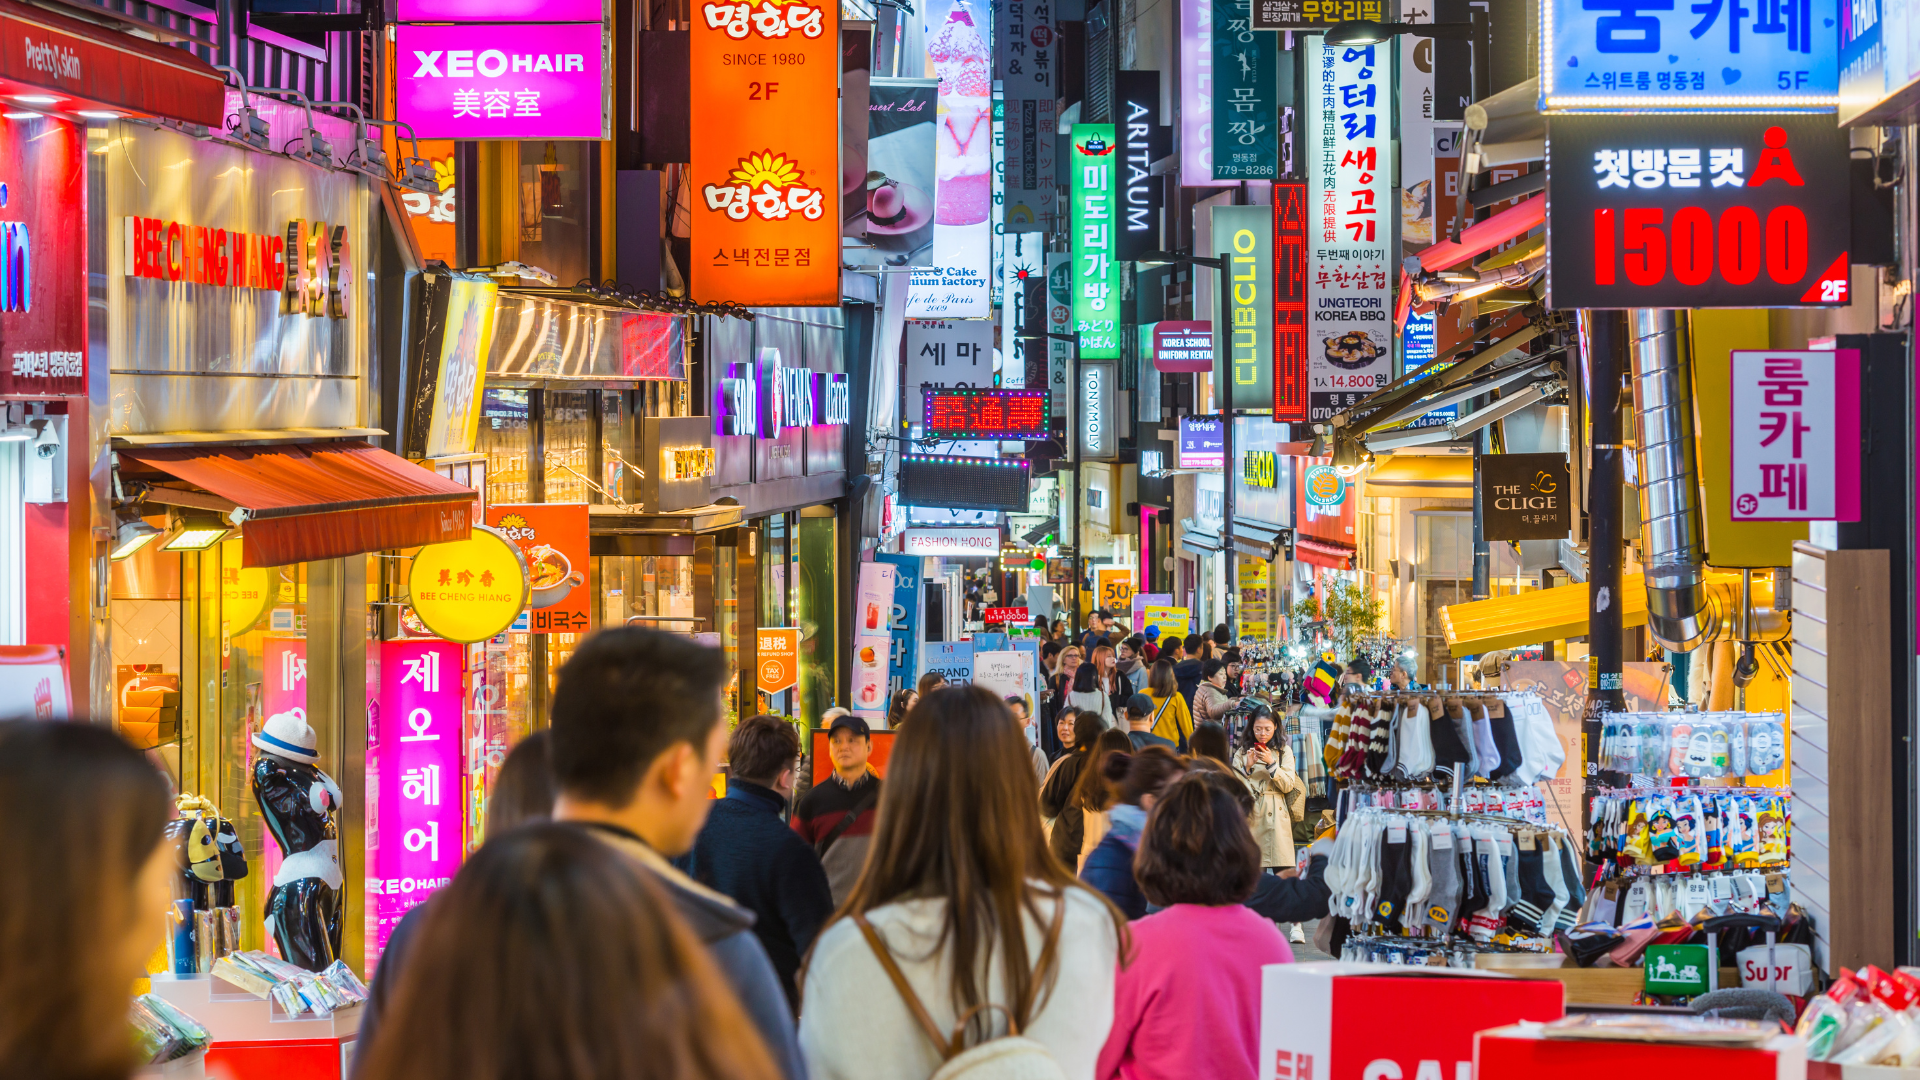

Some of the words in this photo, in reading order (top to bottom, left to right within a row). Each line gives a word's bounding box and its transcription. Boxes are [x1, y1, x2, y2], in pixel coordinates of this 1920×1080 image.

[704, 1, 824, 39] 명화당
[1302, 1, 1381, 22] 무한리필
[1009, 0, 1027, 56] 덕피자
[1034, 0, 1050, 87] 석떡볶이
[413, 49, 509, 78] XEO
[512, 54, 584, 73] HAIR
[723, 53, 767, 66] SINCE
[772, 53, 806, 66] 1980
[1584, 71, 1651, 90] 스위트룸
[1657, 71, 1706, 90] 명동점
[1778, 71, 1810, 90] 5F
[749, 82, 779, 101] 2F
[453, 87, 542, 119] 美容室
[897, 99, 926, 112] Lab
[1024, 101, 1034, 124] Pizza
[1227, 88, 1266, 145] 몸짱
[1127, 100, 1150, 231] ARITAUM
[1232, 153, 1257, 163] 명동점
[1217, 166, 1274, 176] 779-8286
[1593, 148, 1702, 189] 첫방문
[1709, 148, 1745, 189] 컷
[704, 183, 823, 220] 명화당
[1083, 164, 1111, 311] 미도리가방
[1594, 204, 1809, 287] 15000
[133, 215, 164, 282] BEE
[165, 221, 229, 287] CHENG
[232, 232, 286, 292] HIANG
[713, 247, 811, 267] 스낵전문점
[1316, 249, 1350, 261] 두번째
[1352, 249, 1385, 261] 이야기
[946, 267, 977, 276] Cake
[1315, 267, 1386, 290] 무한삼겹
[942, 277, 987, 288] factory
[1820, 280, 1847, 301] 2F
[921, 292, 937, 304] de
[941, 293, 975, 305] Paris
[926, 304, 948, 312] 2009
[1318, 297, 1382, 308] UNGTEORI
[1078, 319, 1114, 332] みどり
[1315, 311, 1357, 322] KOREA
[1360, 311, 1386, 322] BBQ
[1079, 335, 1116, 349] かばん
[1162, 338, 1185, 348] KOREA
[1186, 338, 1212, 348] SCHOOL
[1158, 350, 1188, 360] UNIFORM
[782, 367, 813, 428] VENUS
[1087, 370, 1099, 450] TONYMOLY
[1757, 357, 1811, 511] 룸카페
[1493, 485, 1521, 495] THE
[1494, 496, 1557, 511] CLIGE
[1739, 496, 1757, 513] 5F
[440, 510, 453, 534] Since
[911, 536, 957, 548] FASHION
[961, 536, 992, 548] HONG
[420, 592, 437, 601] BEE
[439, 592, 475, 602] CHENG
[478, 593, 512, 603] HIANG
[1168, 612, 1186, 620] heart
[759, 637, 787, 651] 退税
[927, 656, 943, 664] Cafe
[399, 651, 440, 862] 제오헤어
